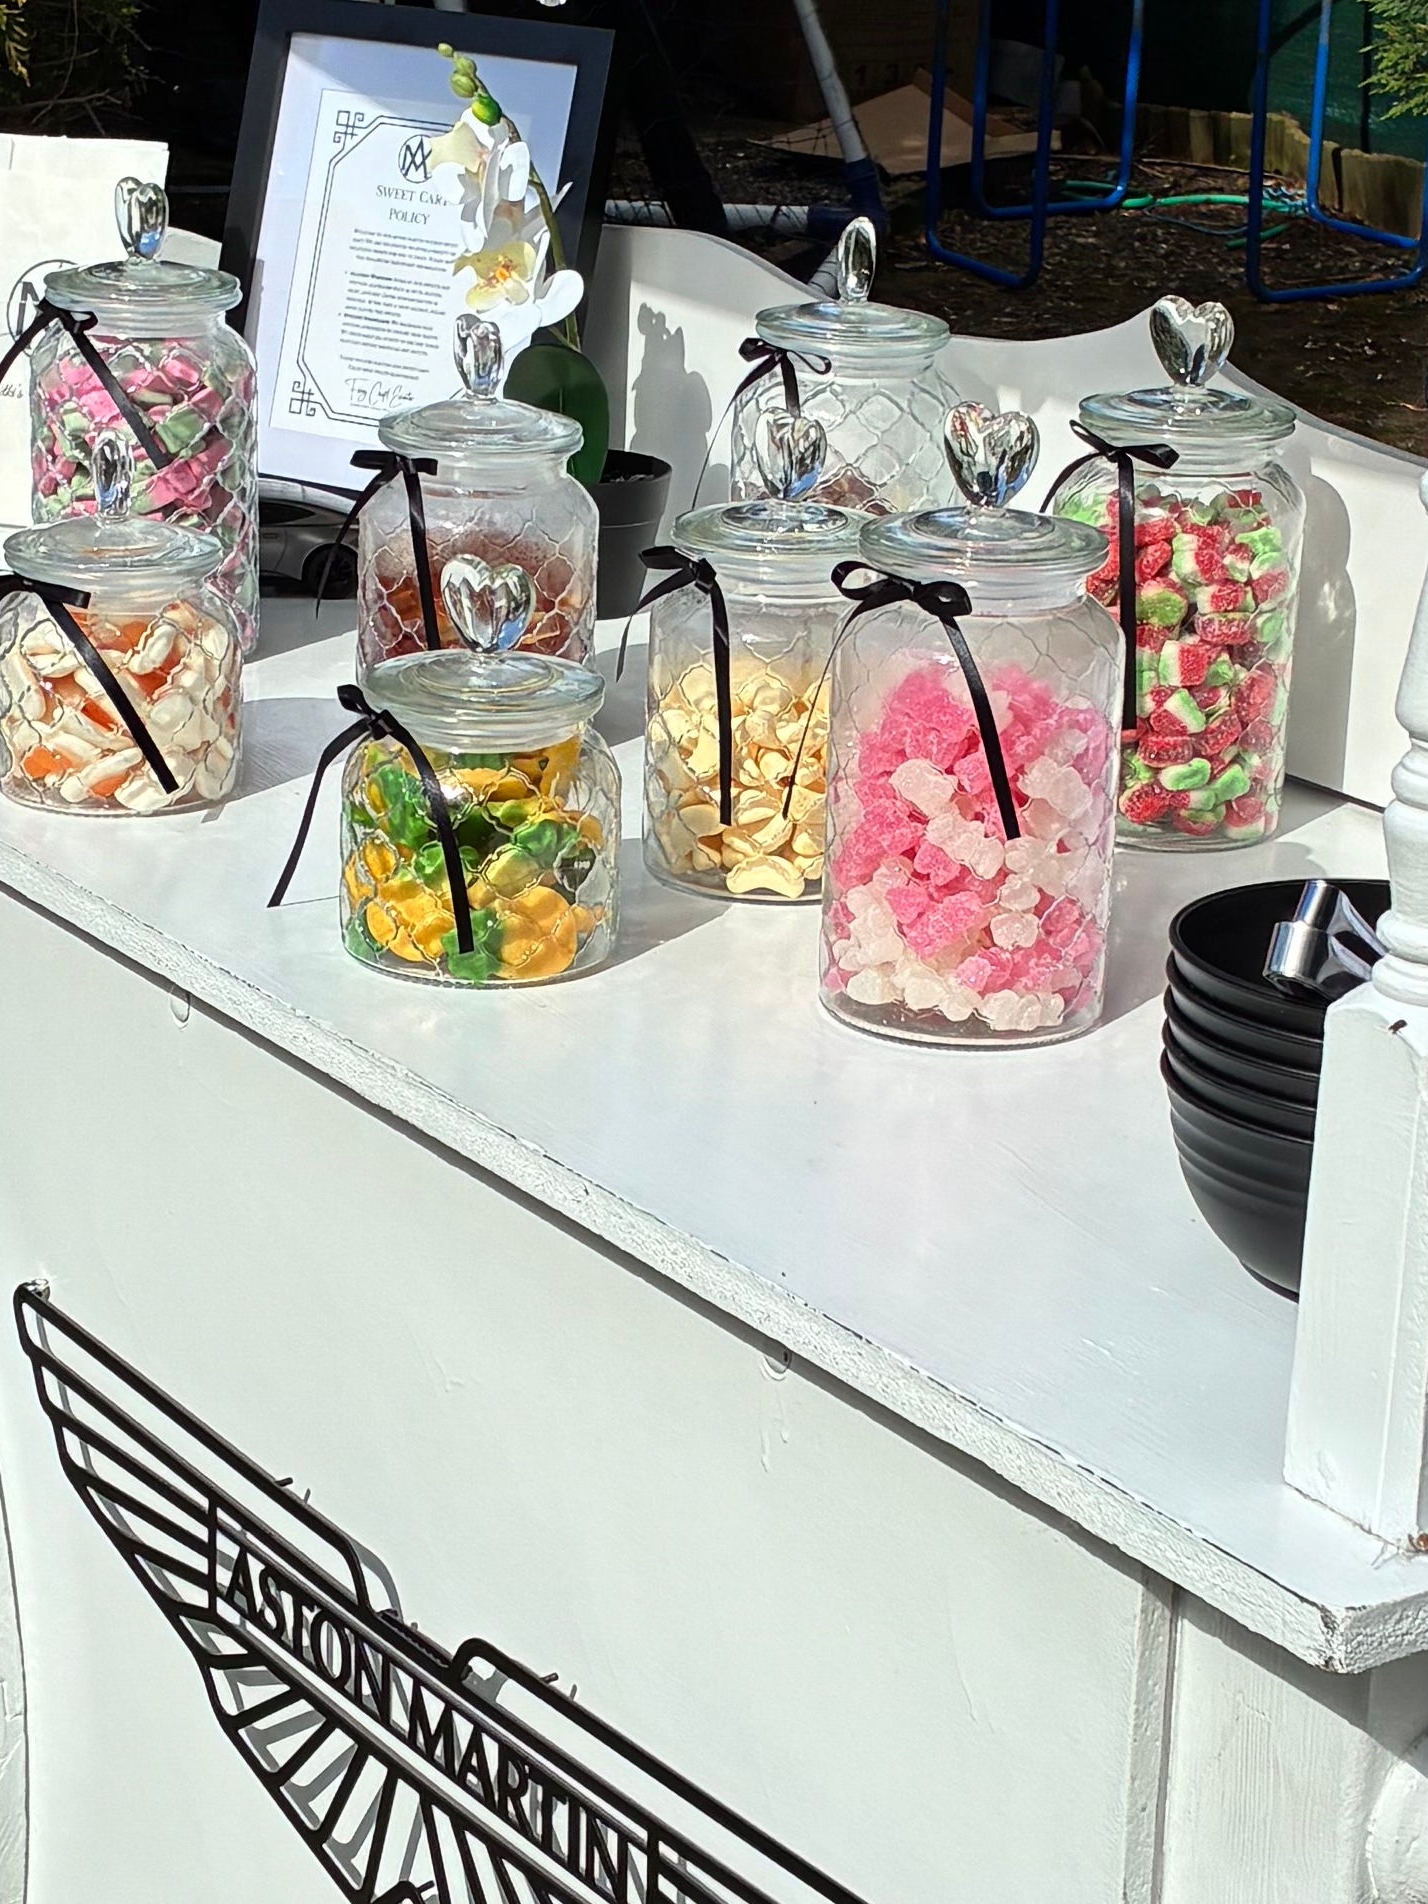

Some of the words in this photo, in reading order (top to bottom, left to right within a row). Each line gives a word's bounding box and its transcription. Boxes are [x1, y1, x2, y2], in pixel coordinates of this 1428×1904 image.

[376, 184, 416, 202] SWEET
[389, 208, 431, 225] POLICY
[225, 1544, 392, 1727] ASTON
